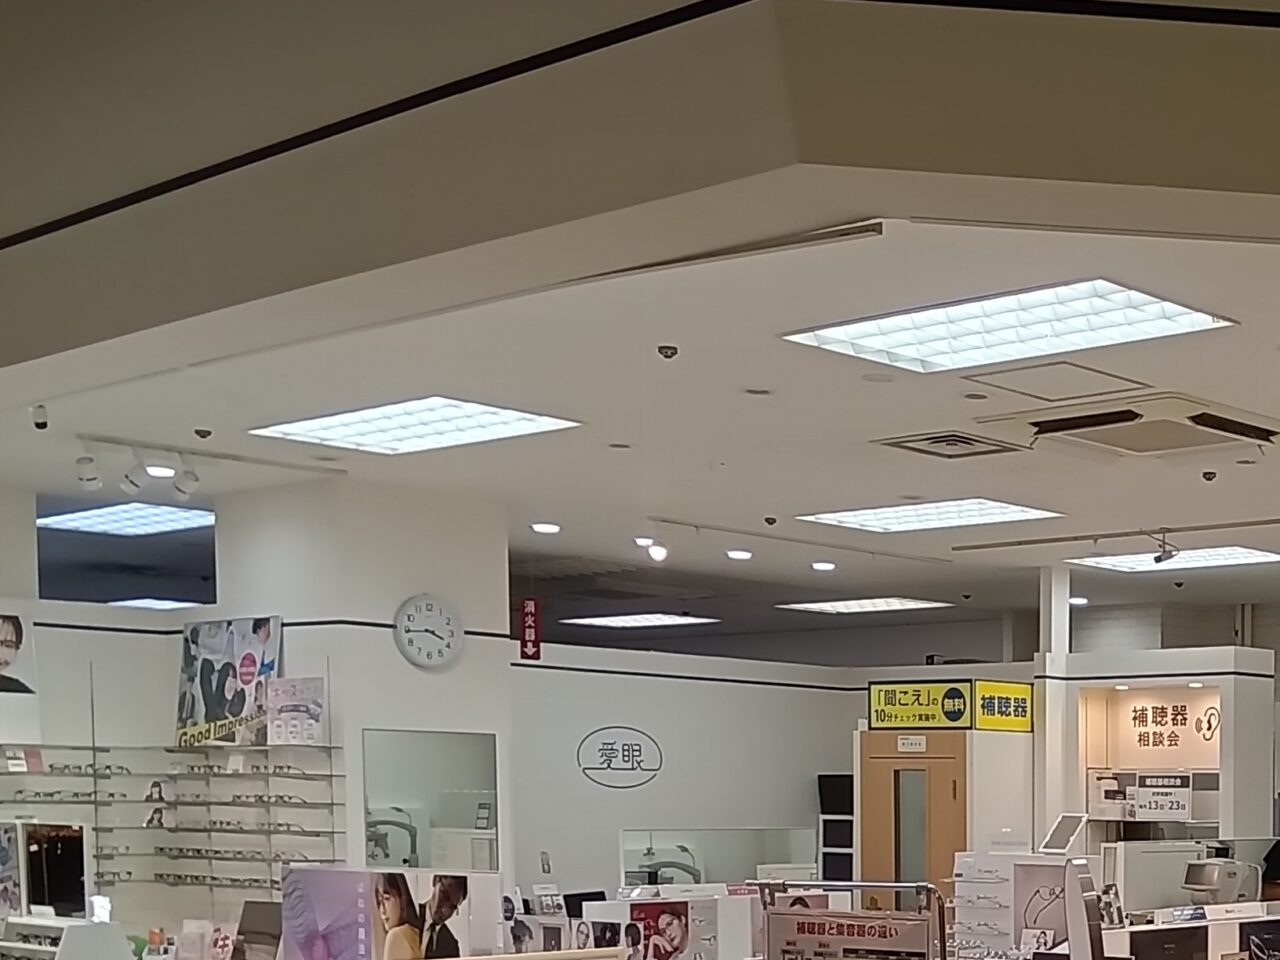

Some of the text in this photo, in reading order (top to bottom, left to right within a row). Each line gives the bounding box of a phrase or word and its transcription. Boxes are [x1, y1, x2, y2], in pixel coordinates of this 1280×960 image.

[877, 689, 939, 706] 「聞こえ」の
[943, 697, 965, 713] 無料
[981, 695, 1028, 718] 補聴器
[1132, 705, 1188, 728] 補聴器
[178, 725, 211, 748] Good
[1137, 731, 1180, 747] 相談会
[598, 741, 644, 770] 愛眼
[796, 921, 899, 940] 補聴器と集音器の違い
